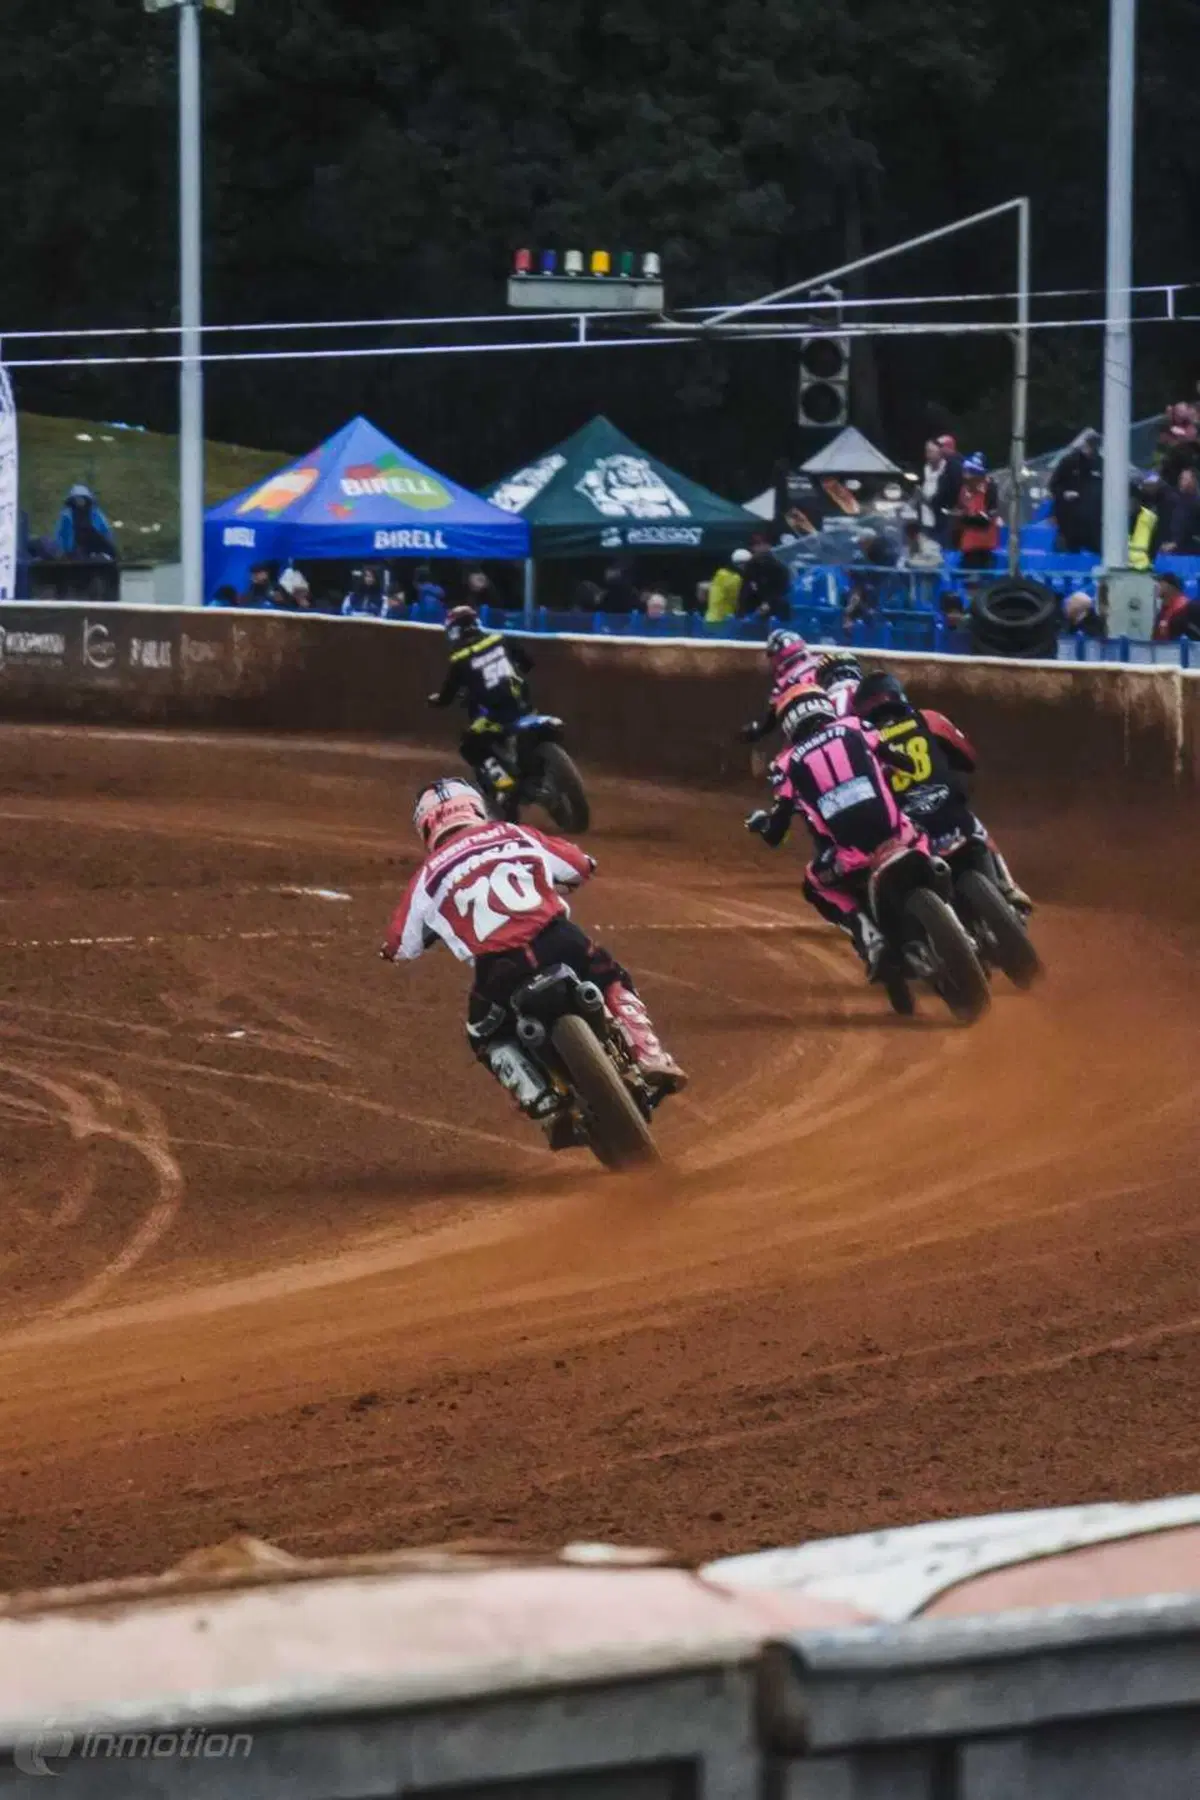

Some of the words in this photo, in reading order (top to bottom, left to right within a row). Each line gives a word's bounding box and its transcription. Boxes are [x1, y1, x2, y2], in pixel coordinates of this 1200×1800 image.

[340, 478, 437, 496] BIRELL
[374, 529, 447, 549] BIRELL
[803, 737, 855, 794] 11
[454, 861, 543, 942] 70
